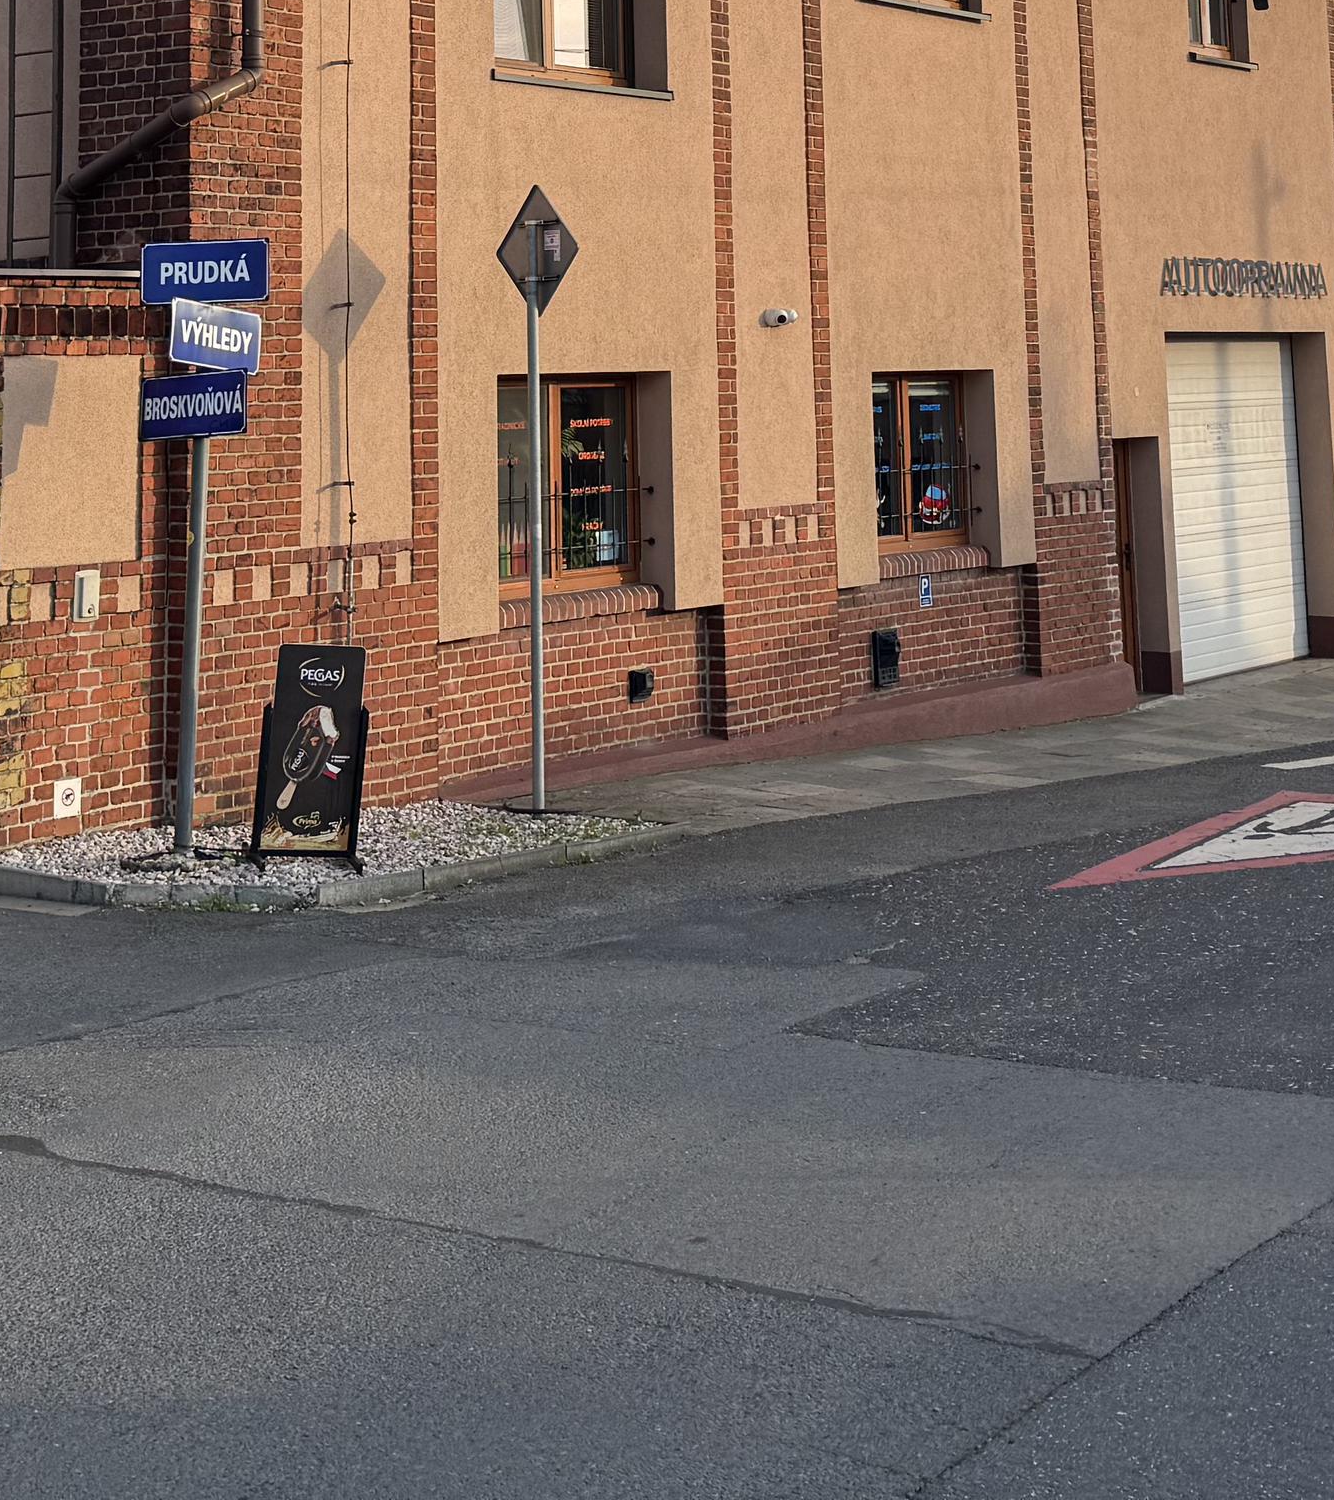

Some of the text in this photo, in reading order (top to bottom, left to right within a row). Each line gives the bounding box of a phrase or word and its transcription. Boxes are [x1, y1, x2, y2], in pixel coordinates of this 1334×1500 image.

[160, 253, 251, 286] PRUDKÁ
[181, 316, 253, 355] VÝHLEDY
[143, 383, 243, 422] BROSKVOŇOVÁ
[300, 667, 341, 683] PEGAS
